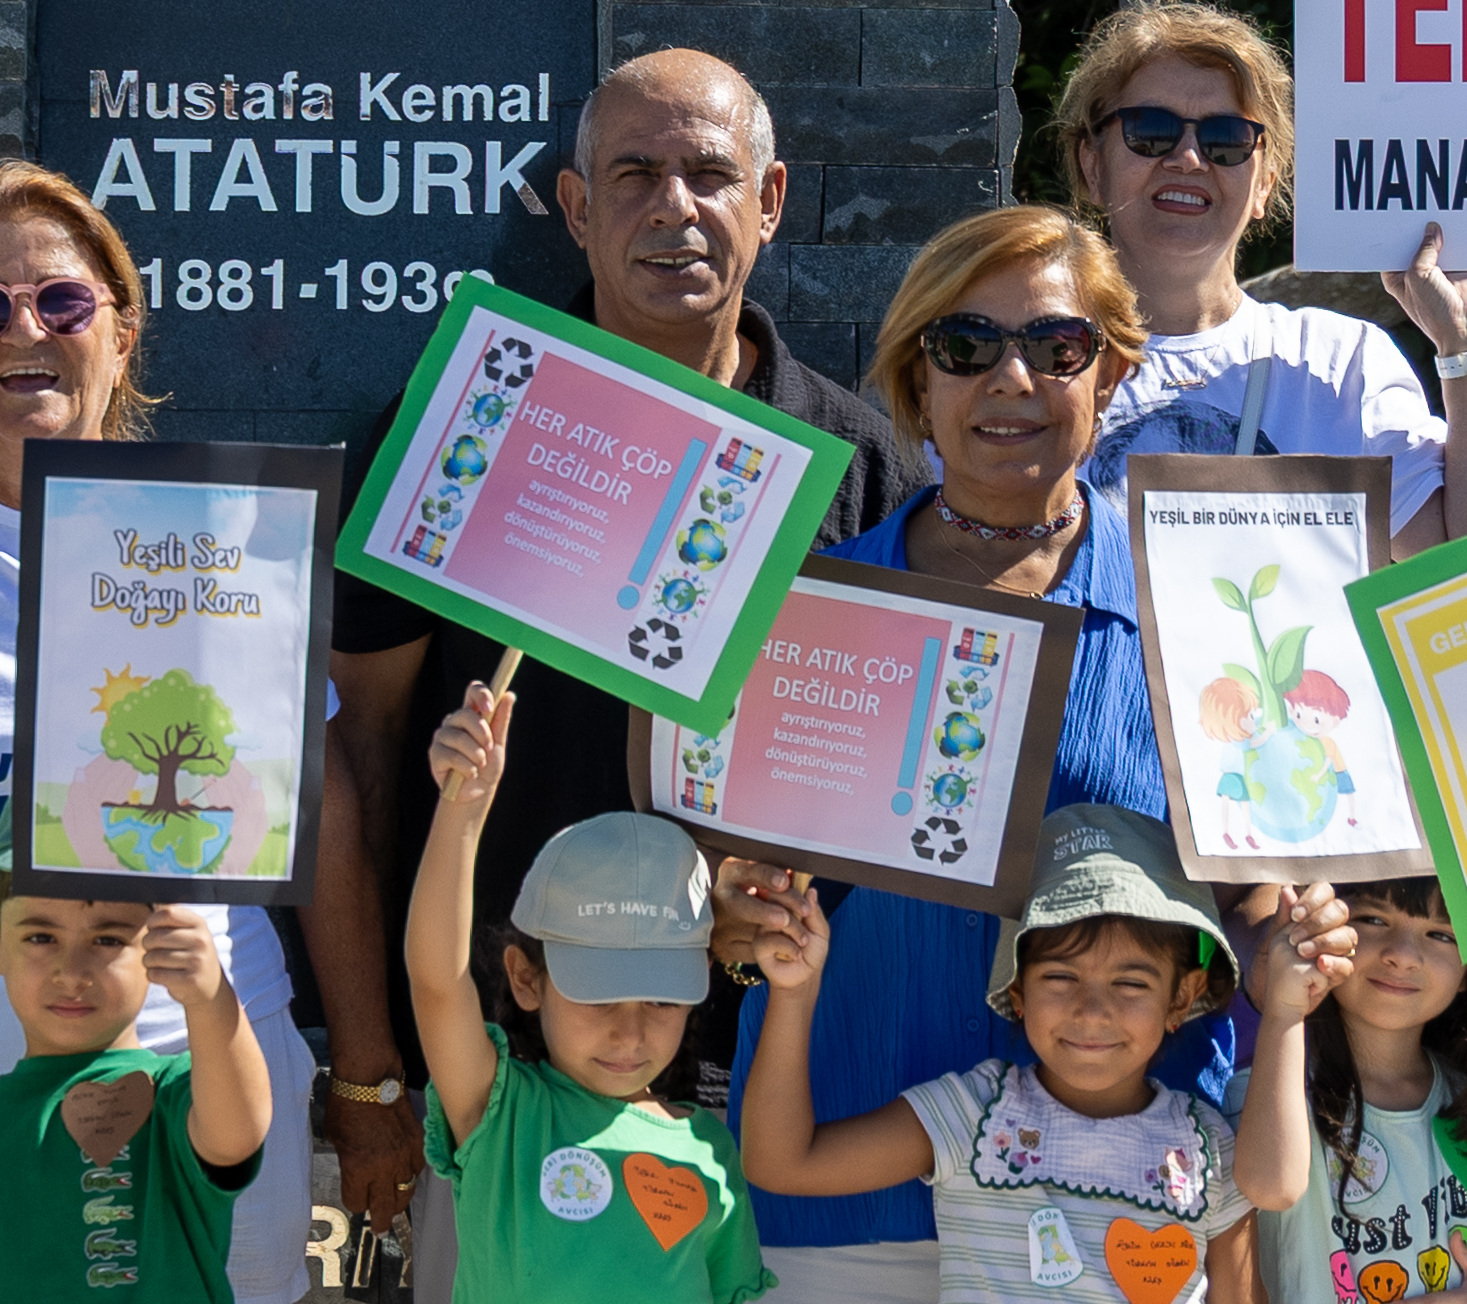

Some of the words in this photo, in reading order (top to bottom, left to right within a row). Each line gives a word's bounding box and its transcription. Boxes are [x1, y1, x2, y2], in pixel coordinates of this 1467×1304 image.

[89, 69, 334, 122] Mustafa
[359, 72, 550, 123] Kemal
[90, 138, 550, 216] ATATÜRK
[519, 400, 566, 437] HER
[566, 423, 621, 460] ATIK
[621, 445, 673, 480] ÇÖP
[527, 442, 633, 505] DEĞİLDİR
[1150, 507, 1190, 528] YEŞİL
[1193, 508, 1215, 525] BİR
[1218, 508, 1270, 525] DÜNYA
[1273, 508, 1301, 529] İÇİN
[1304, 512, 1322, 526] EL
[1325, 512, 1354, 526] ELE
[114, 528, 186, 576] Yeşili
[191, 532, 242, 573] Sev
[91, 572, 187, 629] Doğayı
[194, 577, 262, 619] Koru
[805, 647, 858, 677] ATIK
[863, 657, 914, 686] ÇÖP
[773, 676, 881, 717] DEĞİLDİR
[1053, 834, 1114, 861] STAR
[621, 901, 657, 917] HAVE
[559, 1150, 607, 1179] DÖNÜŞÜM
[557, 1206, 594, 1217] AVCISI
[1037, 1269, 1073, 1281] AVCISI
